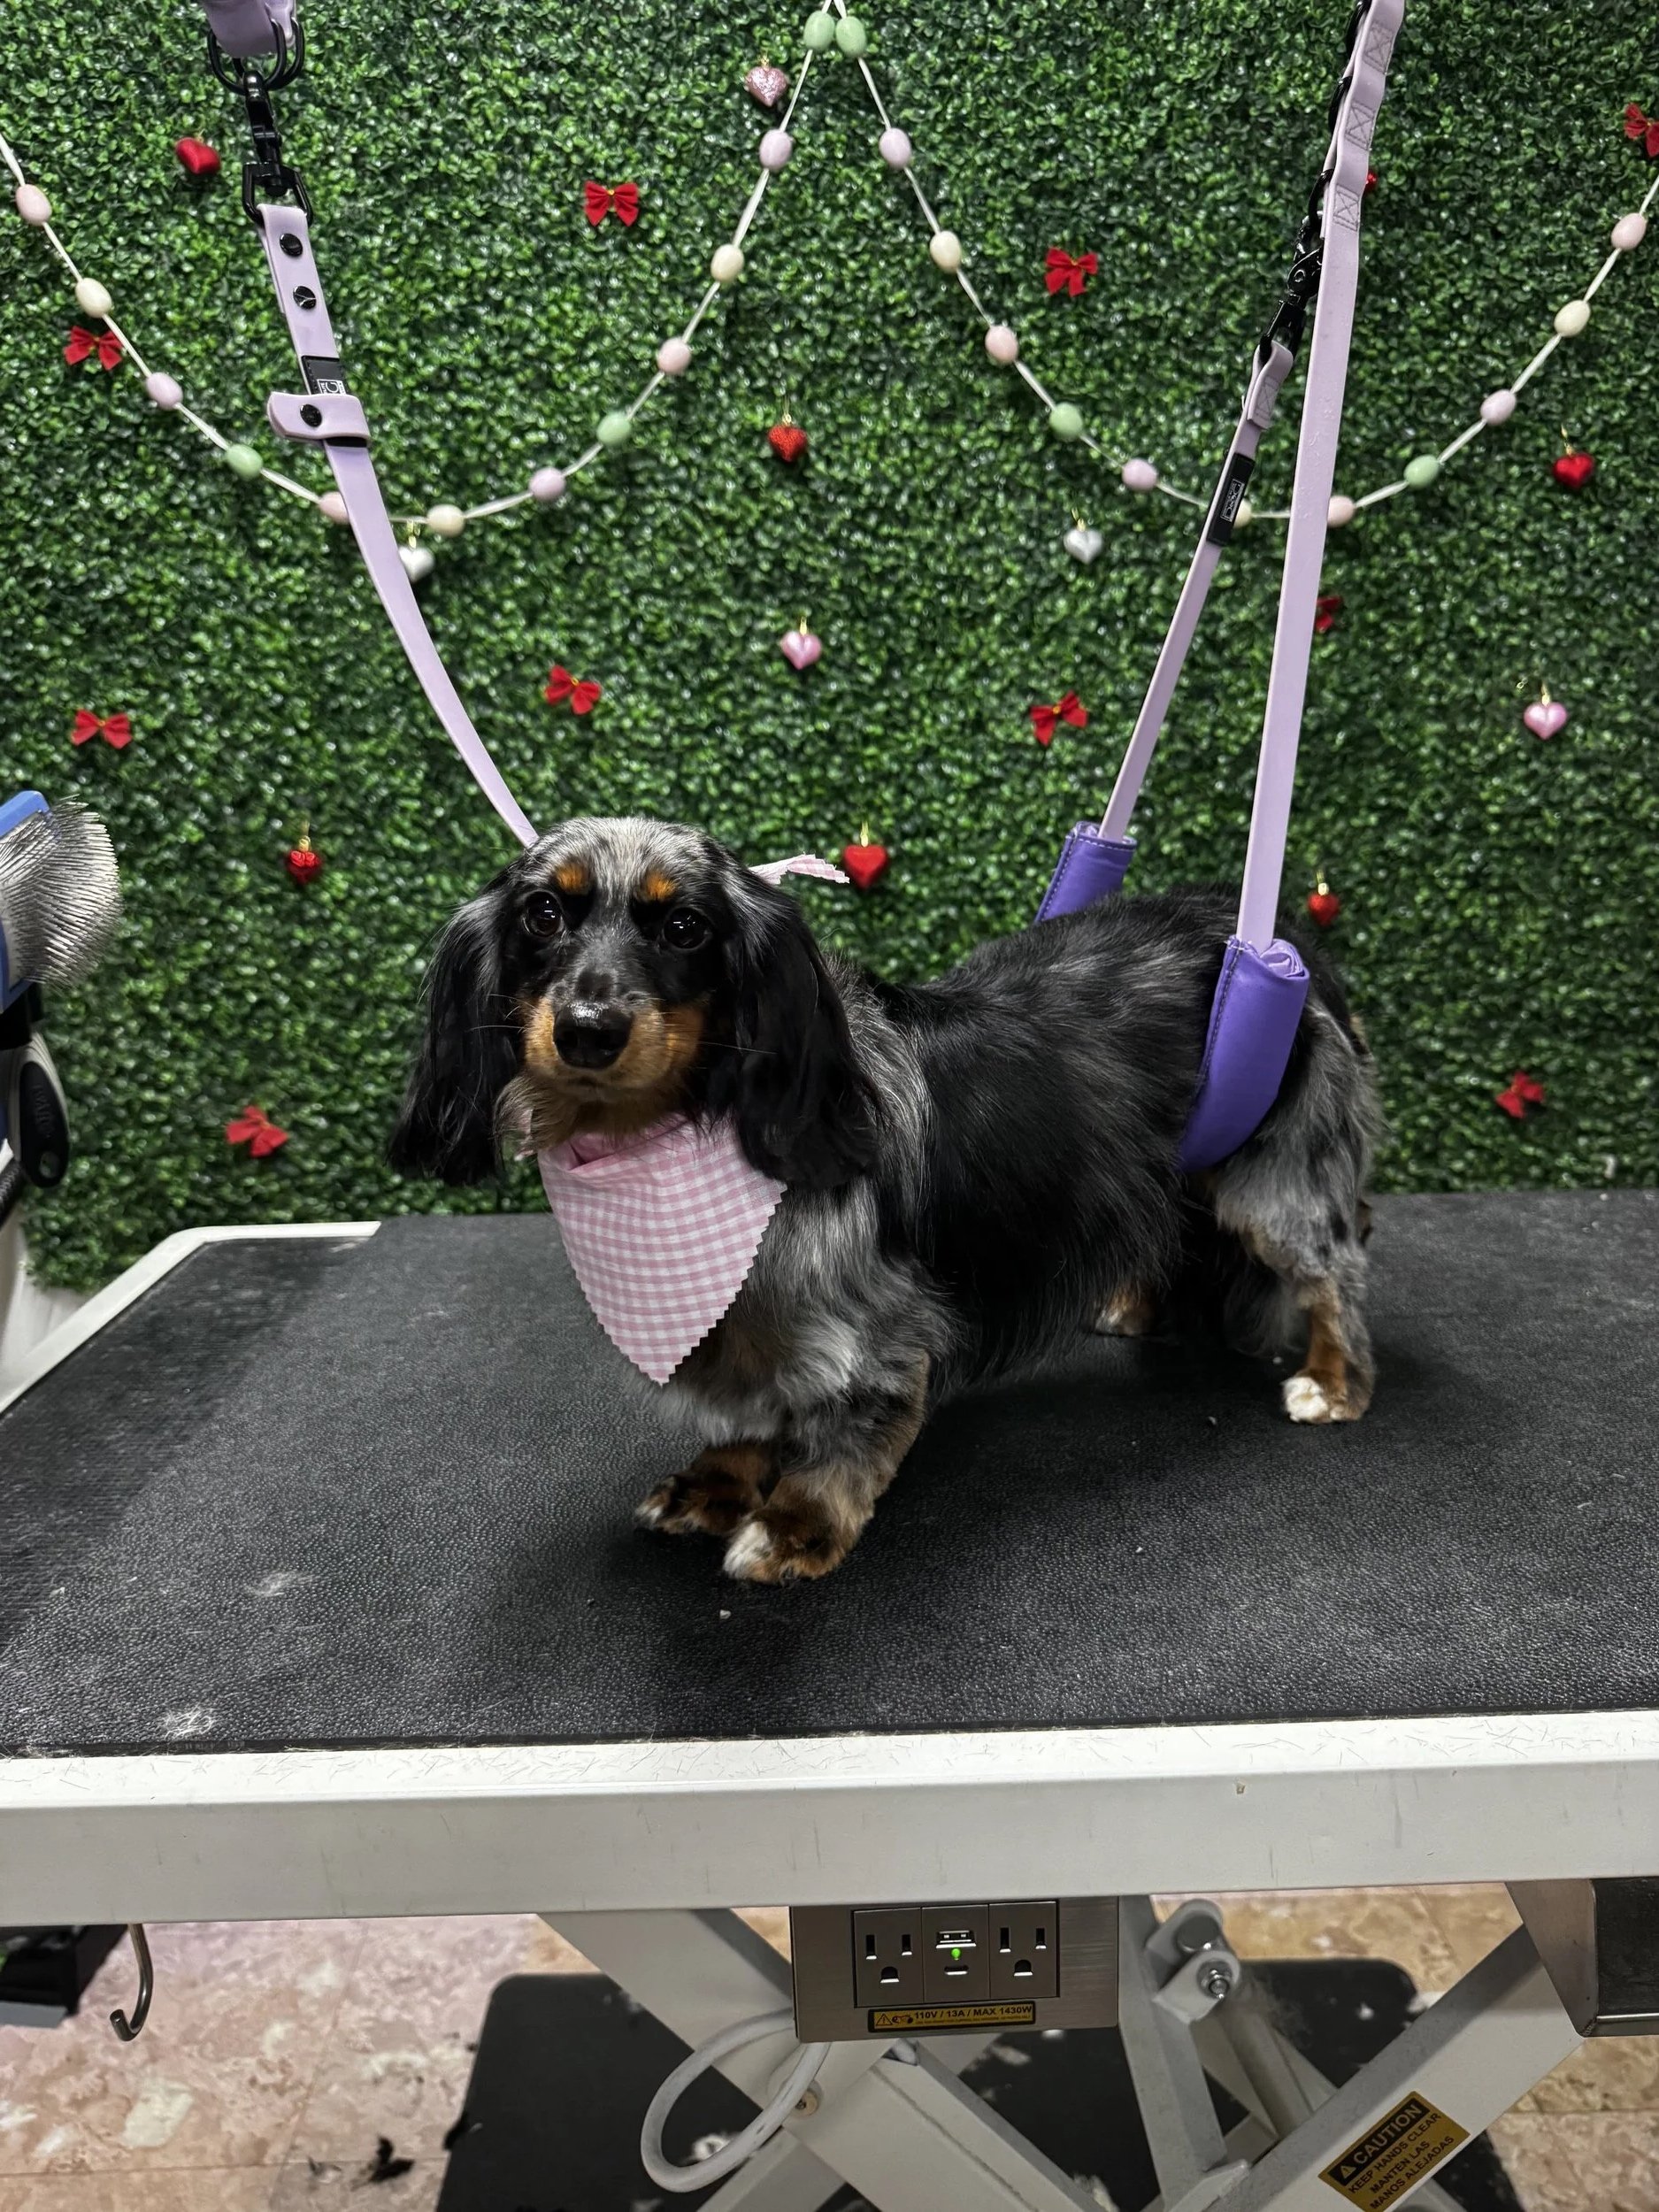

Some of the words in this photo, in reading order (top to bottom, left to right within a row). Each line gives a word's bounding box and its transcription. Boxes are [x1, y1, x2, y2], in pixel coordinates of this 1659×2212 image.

[973, 2008, 996, 2016] MAX
[1000, 2006, 1033, 2015] 1430W
[1348, 2170, 1374, 2194] KEEP
[1374, 2142, 1409, 2171] HANDS
[1408, 2112, 1441, 2142] CLEAR
[1354, 2104, 1423, 2165] CAUTION
[1370, 2158, 1410, 2193] MANTEN
[1411, 2140, 1431, 2161] LAS
[1370, 2179, 1406, 2209] MANOS
[1406, 2136, 1455, 2179] ALEJADAS
